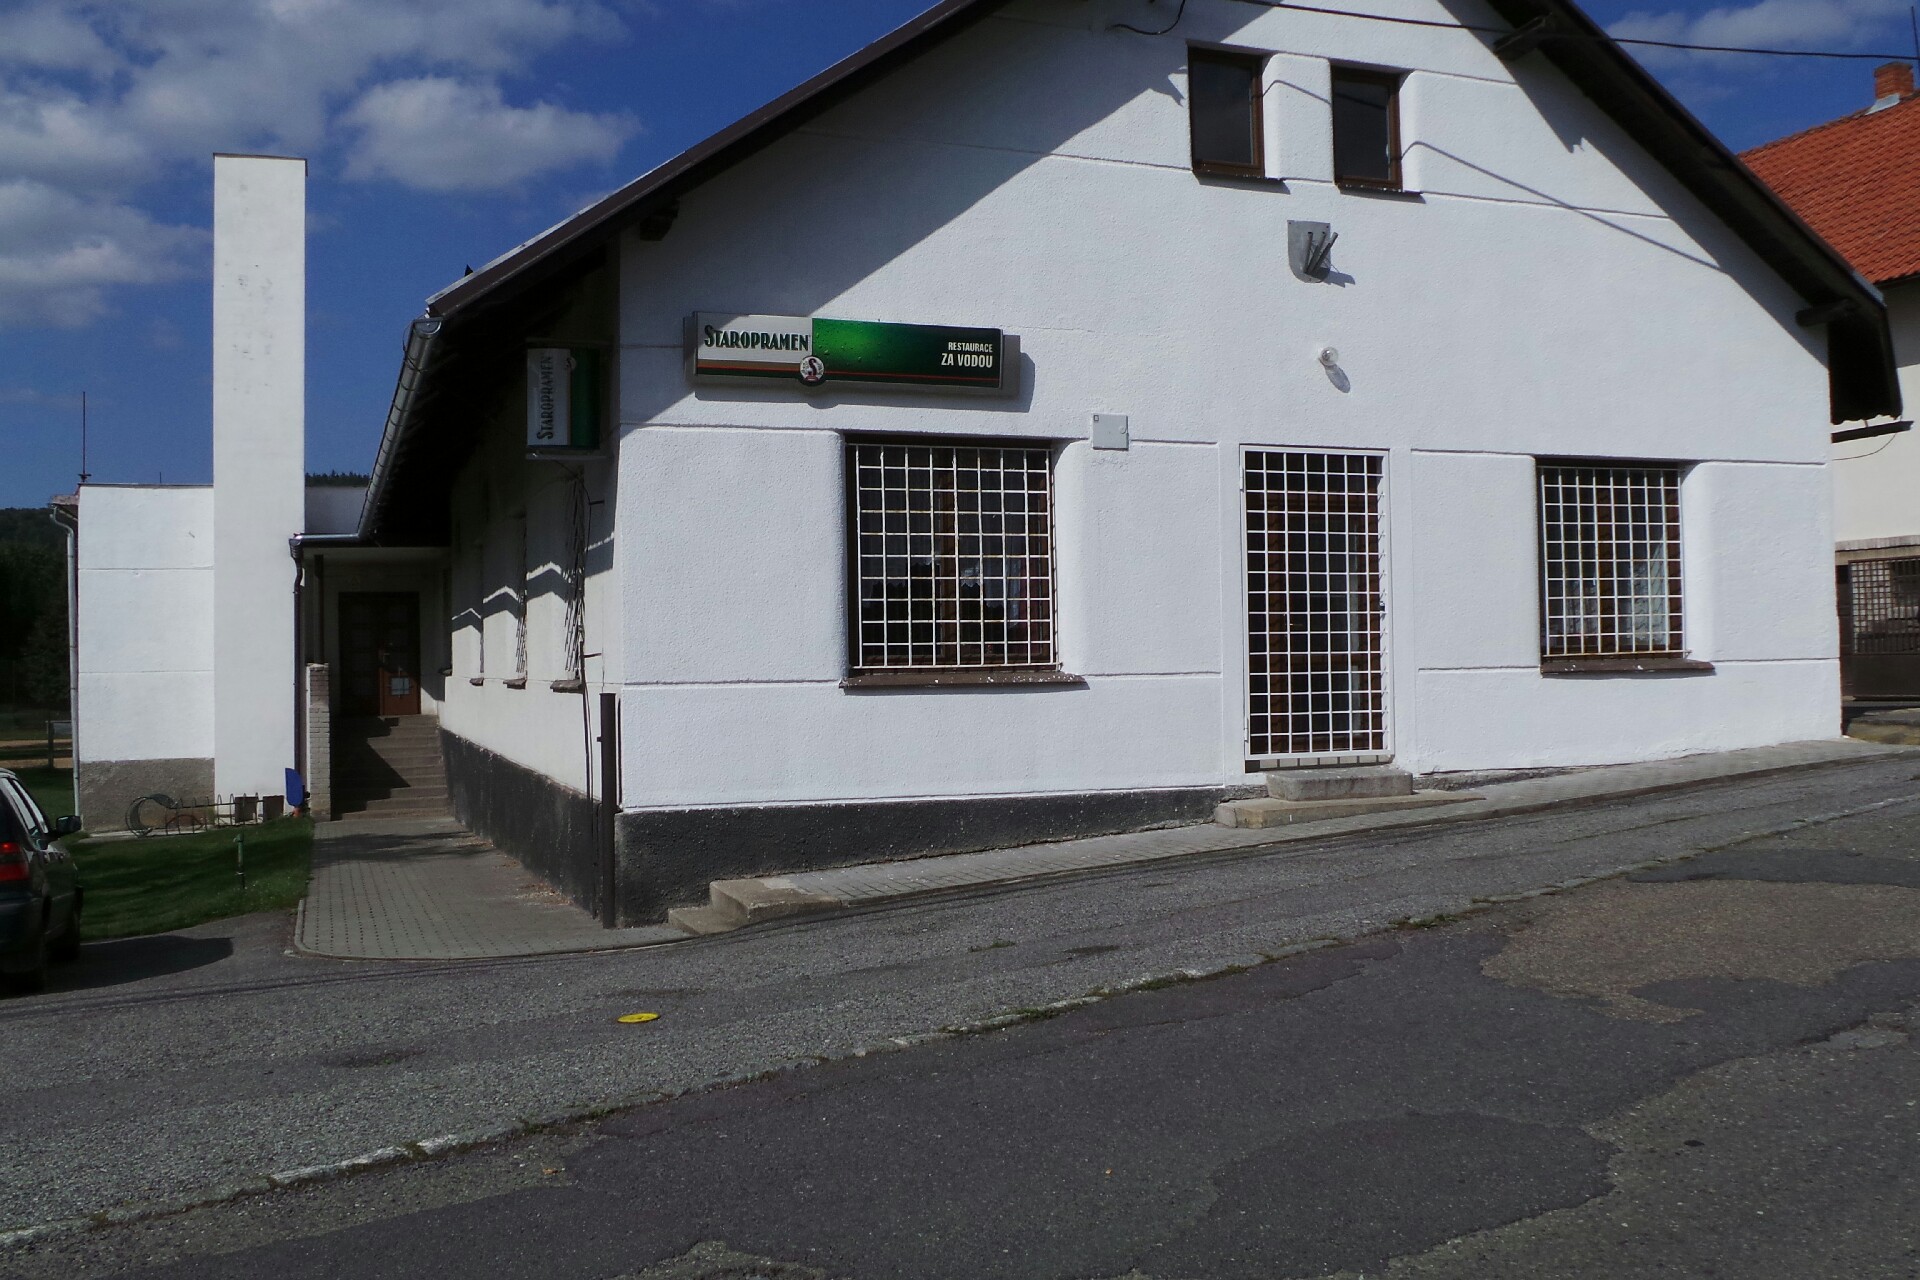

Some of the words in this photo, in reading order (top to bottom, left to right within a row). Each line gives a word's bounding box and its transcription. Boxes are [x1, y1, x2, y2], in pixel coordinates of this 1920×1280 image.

[704, 324, 809, 351] STAROPRAMEN
[948, 341, 993, 353] RESTAURACE
[941, 353, 954, 366] ZA
[957, 354, 993, 368] VODOU
[537, 356, 553, 440] STAROPRAMEN
